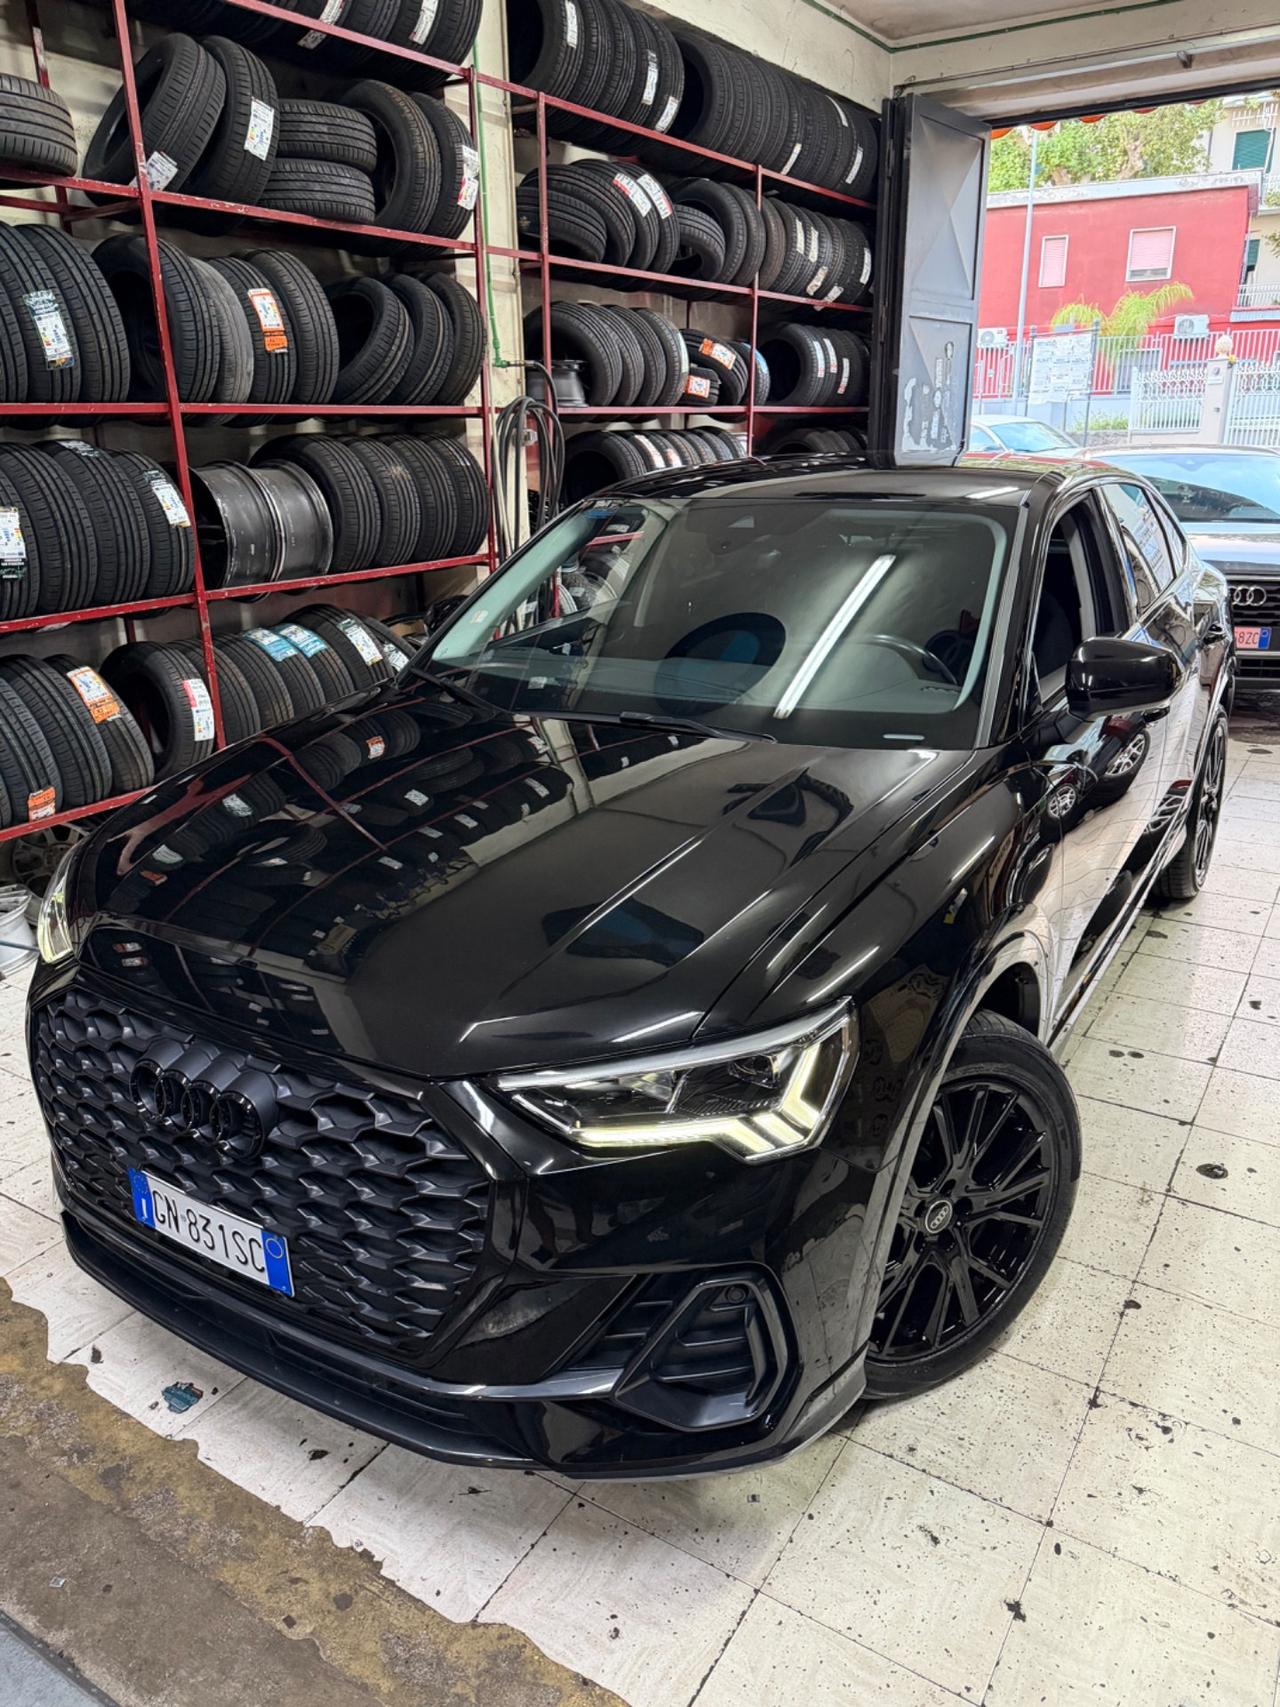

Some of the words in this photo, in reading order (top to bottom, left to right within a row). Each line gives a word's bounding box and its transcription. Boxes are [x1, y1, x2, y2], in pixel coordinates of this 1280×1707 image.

[1235, 631, 1259, 645] 8ZC
[152, 1189, 180, 1233] GN
[186, 1208, 265, 1273] 831SC
